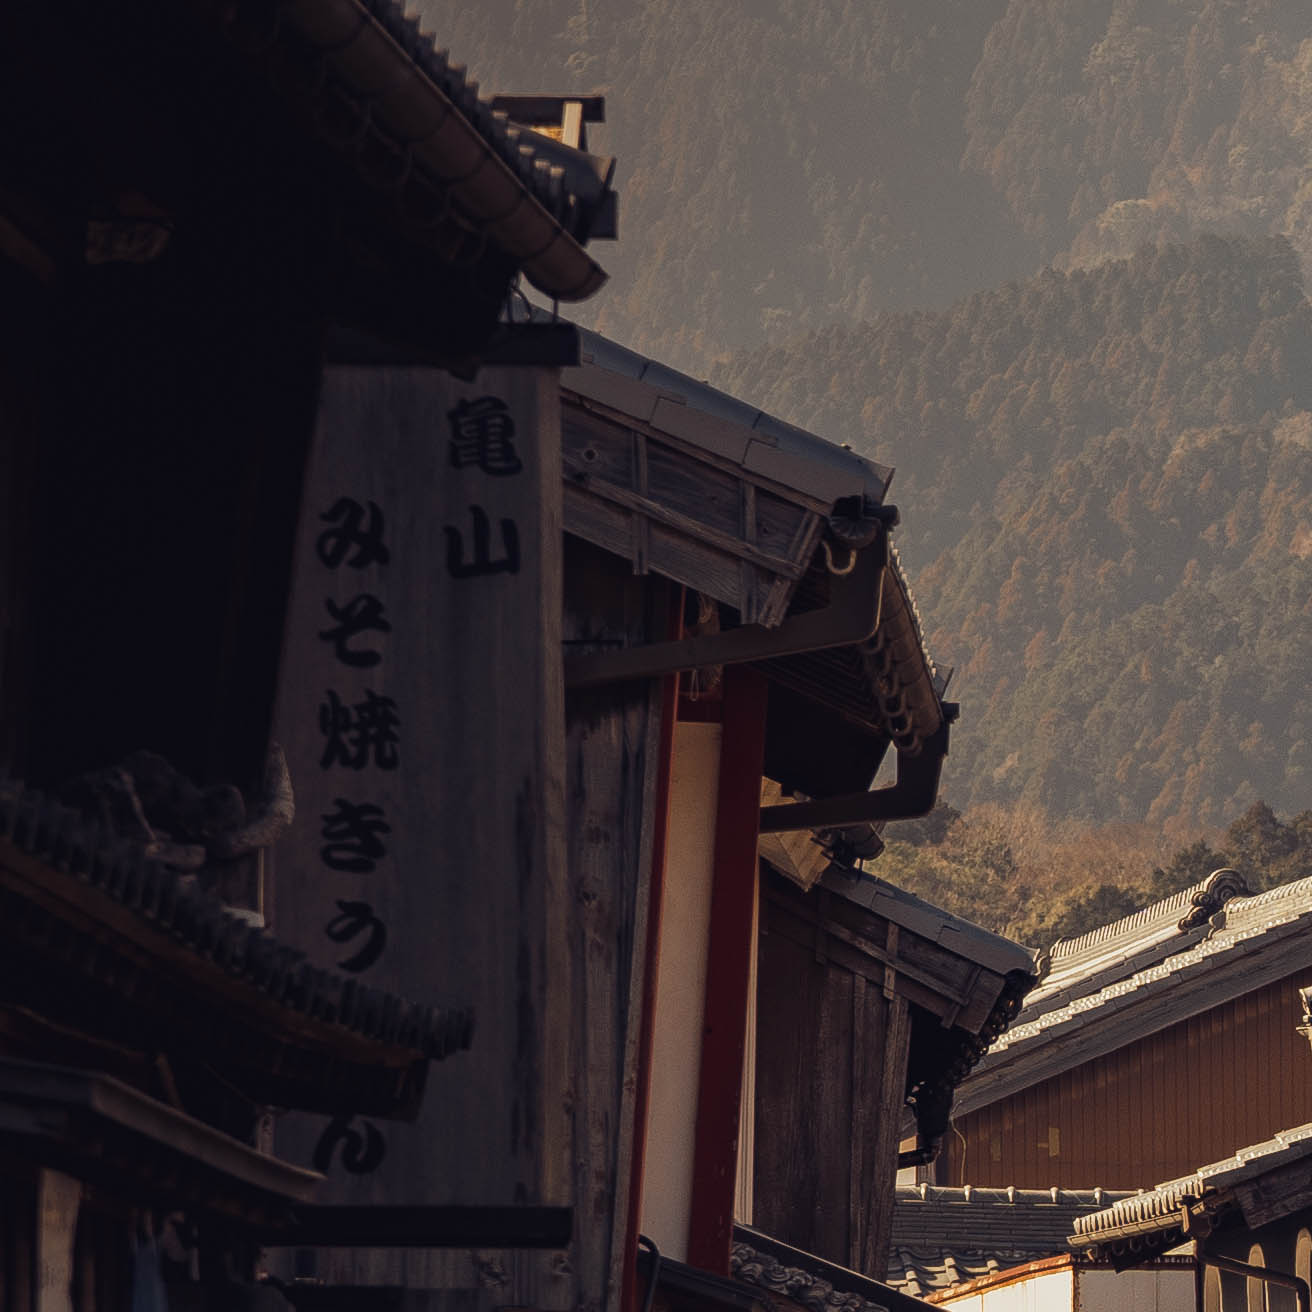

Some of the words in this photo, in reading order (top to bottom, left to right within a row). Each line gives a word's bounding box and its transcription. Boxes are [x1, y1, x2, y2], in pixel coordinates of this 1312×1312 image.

[443, 397, 522, 579] 亀山
[314, 496, 400, 1176] みそ焼きうん
